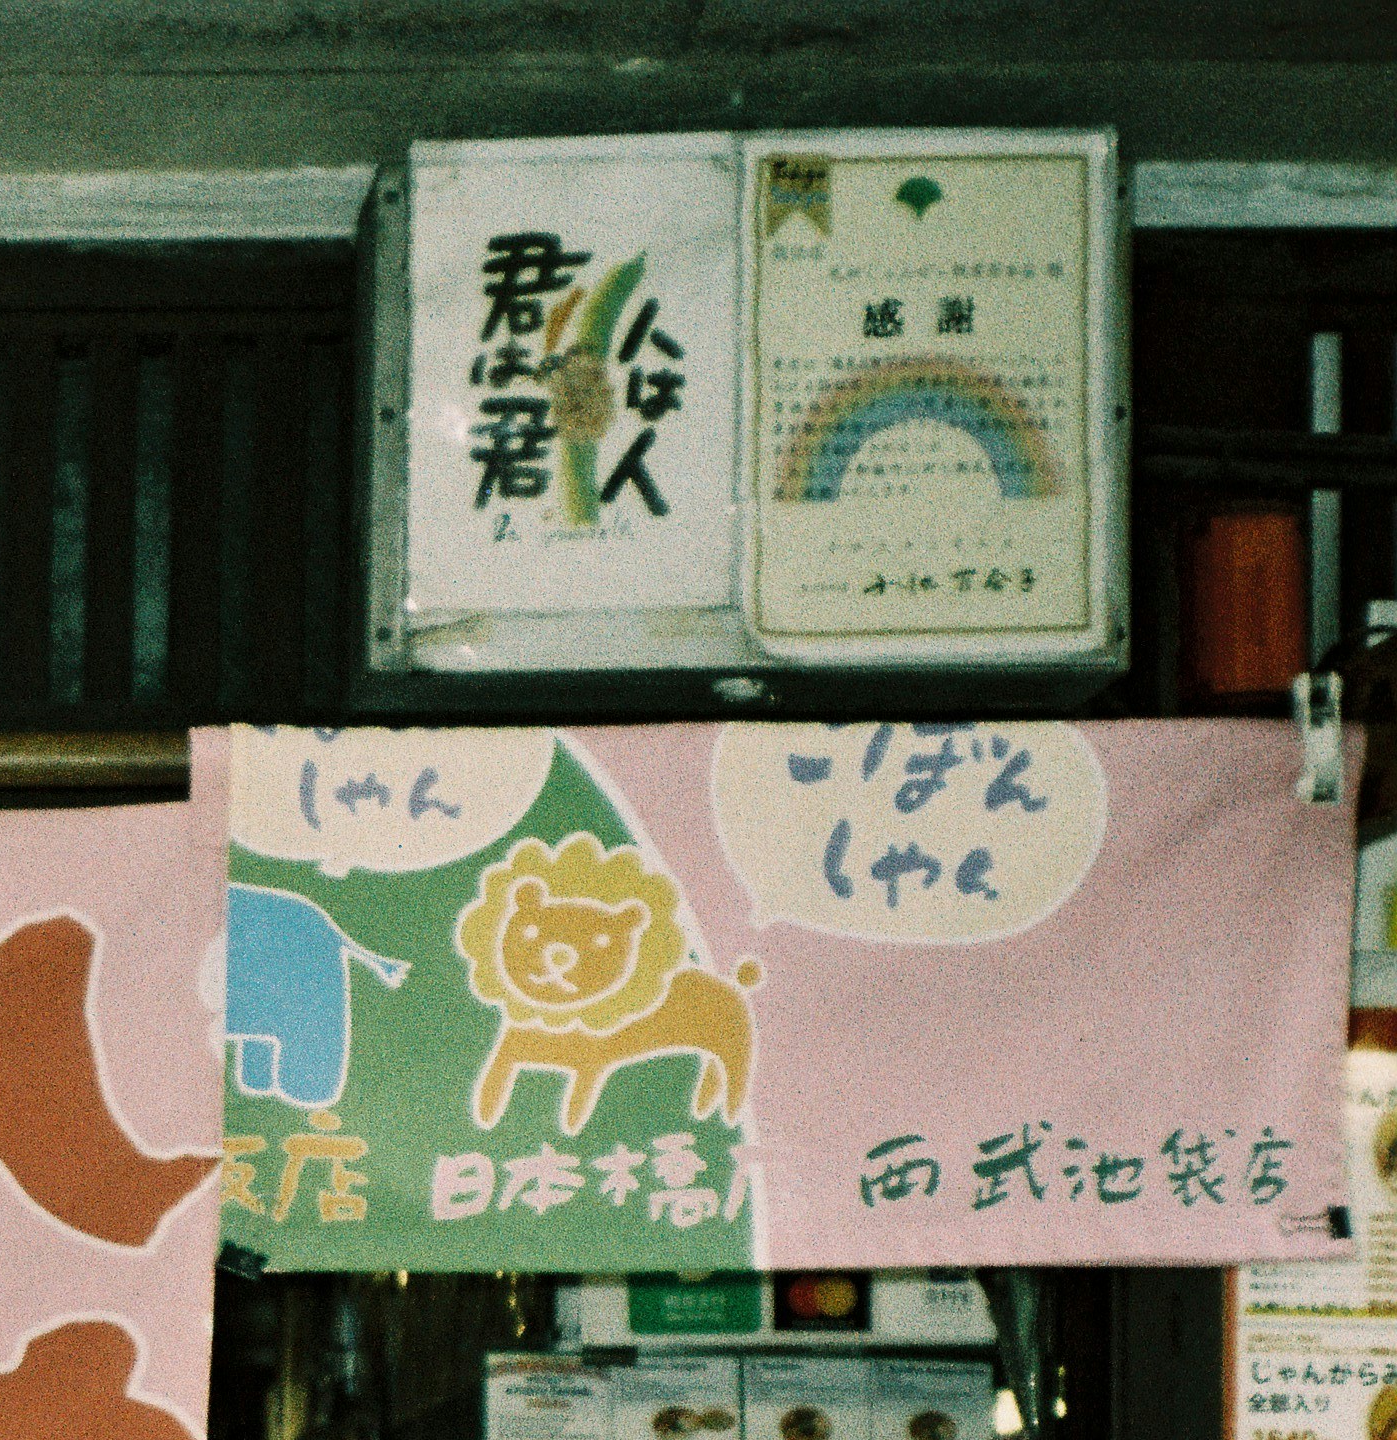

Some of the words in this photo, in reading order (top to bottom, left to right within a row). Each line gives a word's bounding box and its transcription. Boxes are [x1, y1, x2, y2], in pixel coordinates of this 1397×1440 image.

[863, 294, 976, 337] 感謝
[469, 231, 593, 509] 君は君
[600, 297, 686, 516] 人は人
[299, 760, 462, 831] しゃん
[822, 818, 1001, 908] しゃん
[857, 1120, 1293, 1210] 西武池袋店
